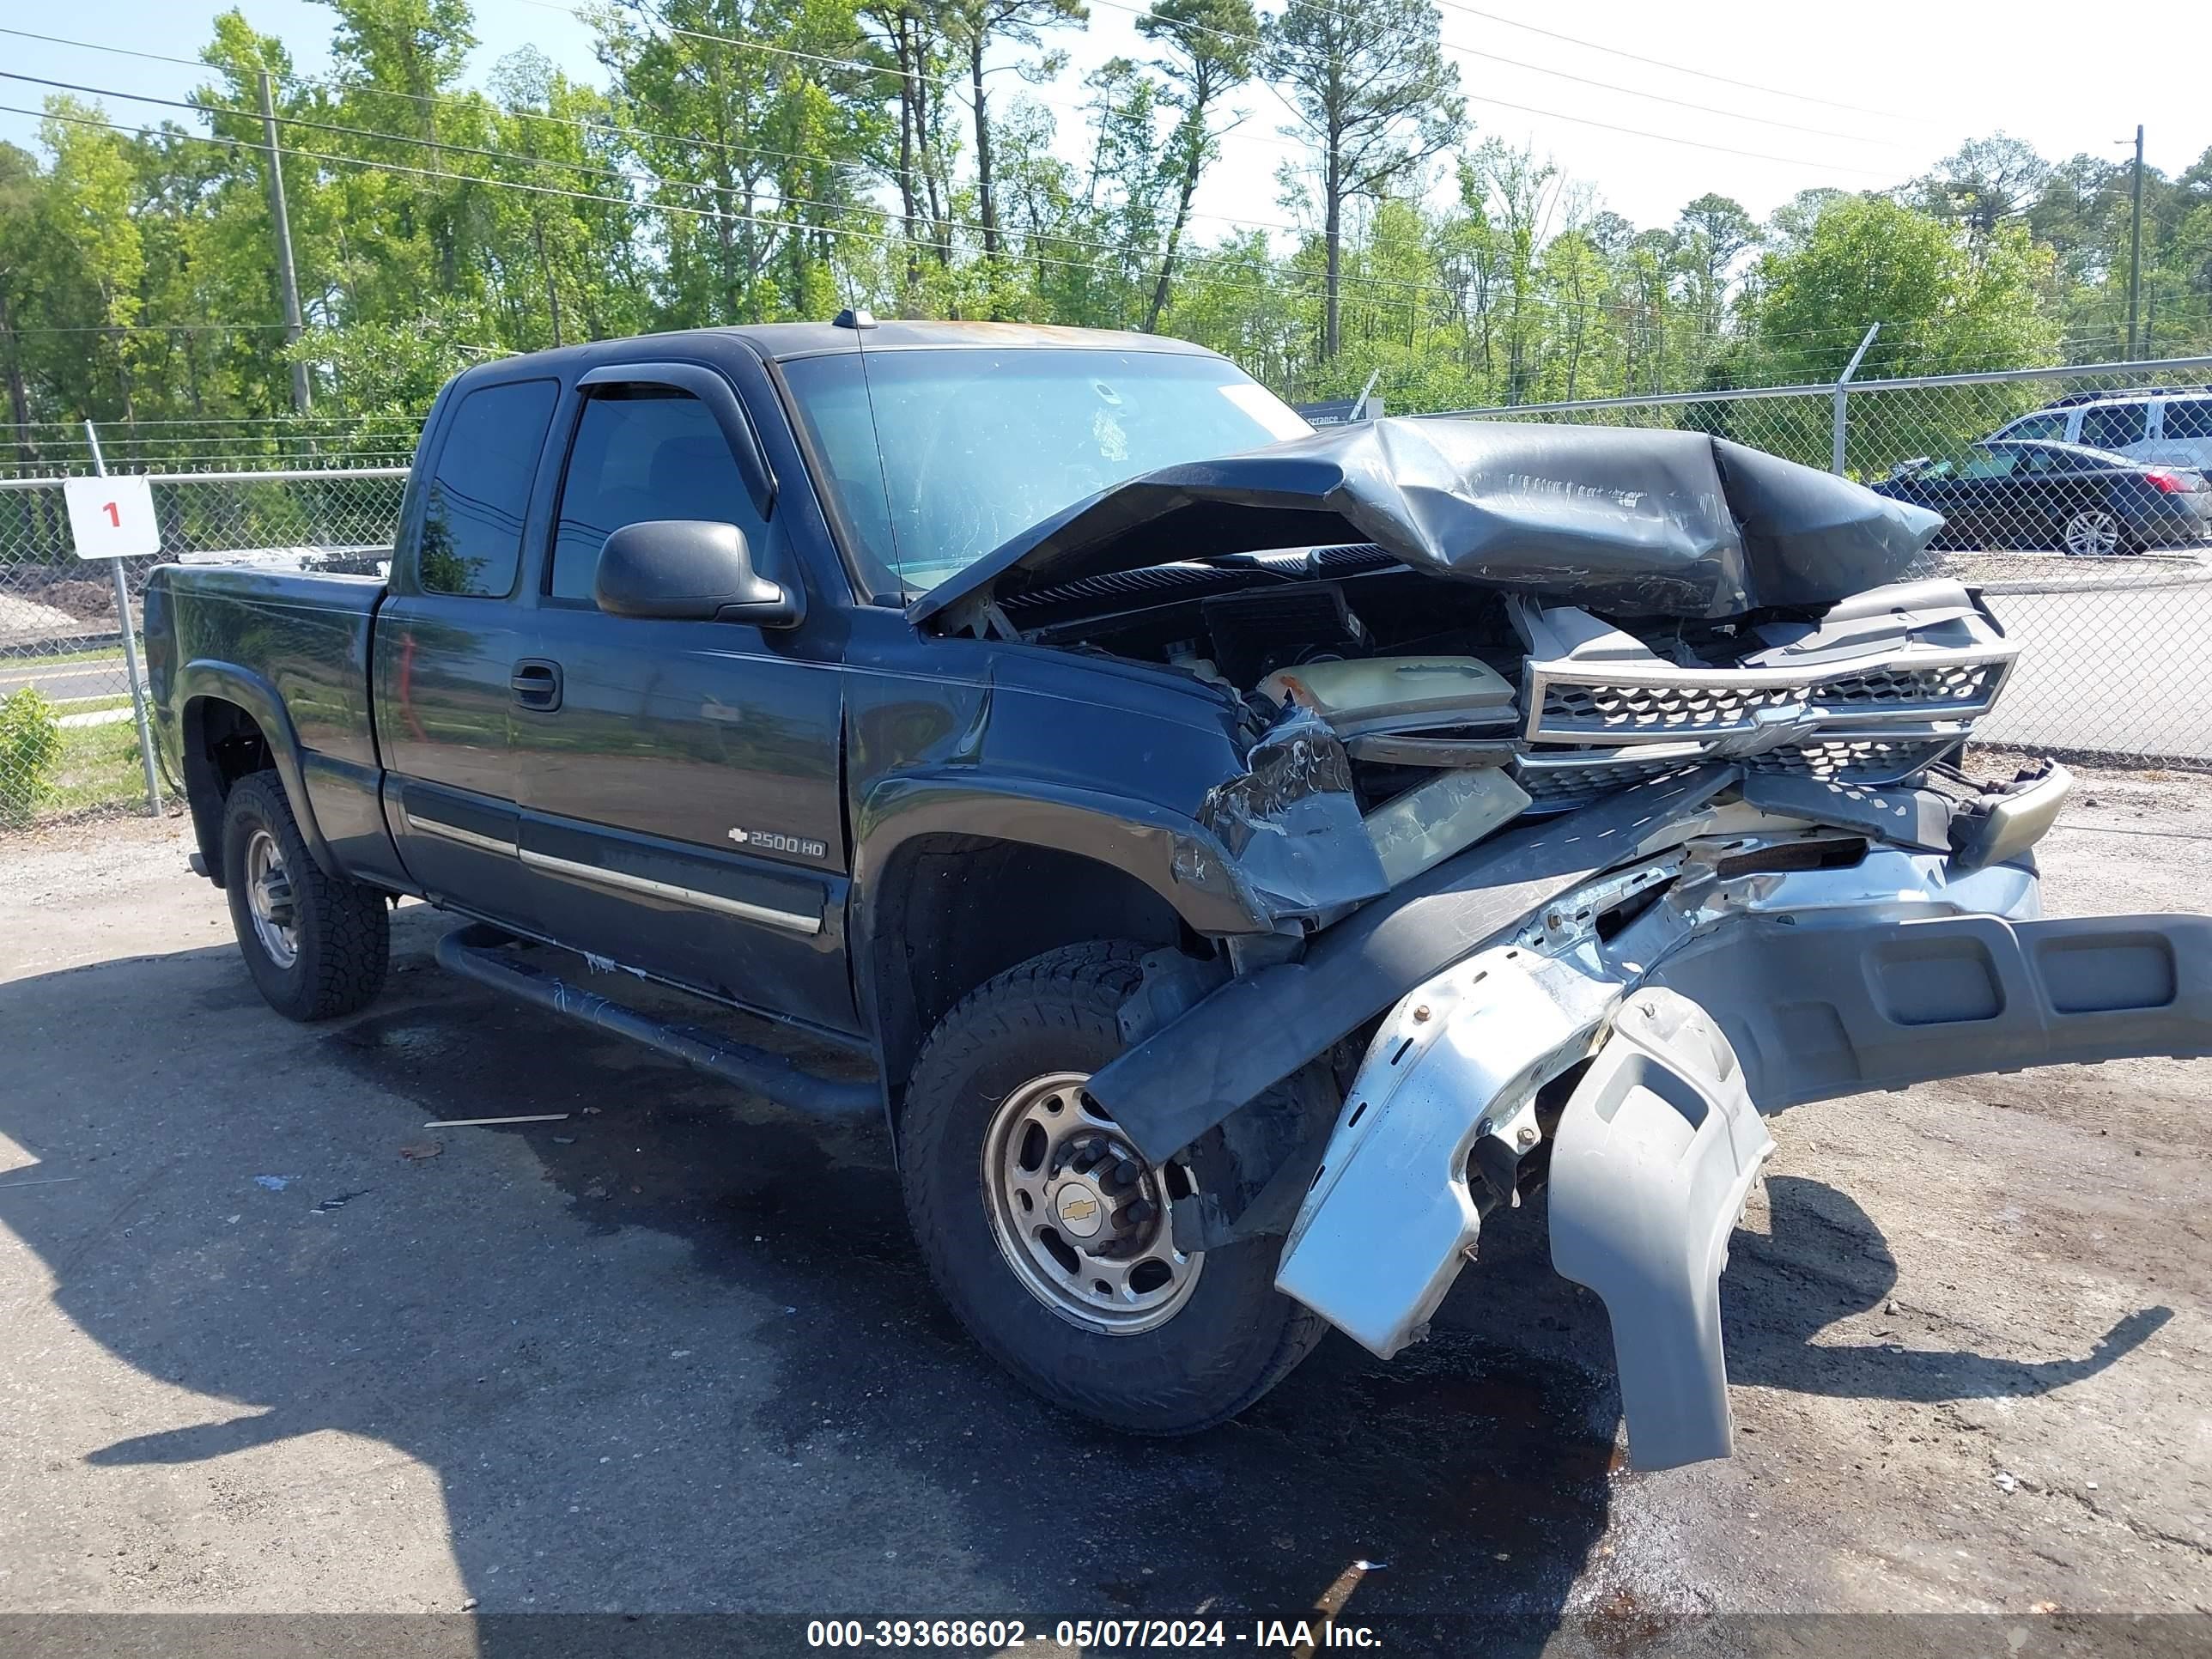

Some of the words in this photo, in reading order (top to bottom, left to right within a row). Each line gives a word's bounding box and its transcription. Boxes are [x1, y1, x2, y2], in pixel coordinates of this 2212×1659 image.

[102, 501, 121, 528] 1
[750, 831, 799, 853] 2500
[802, 843, 823, 856] HD
